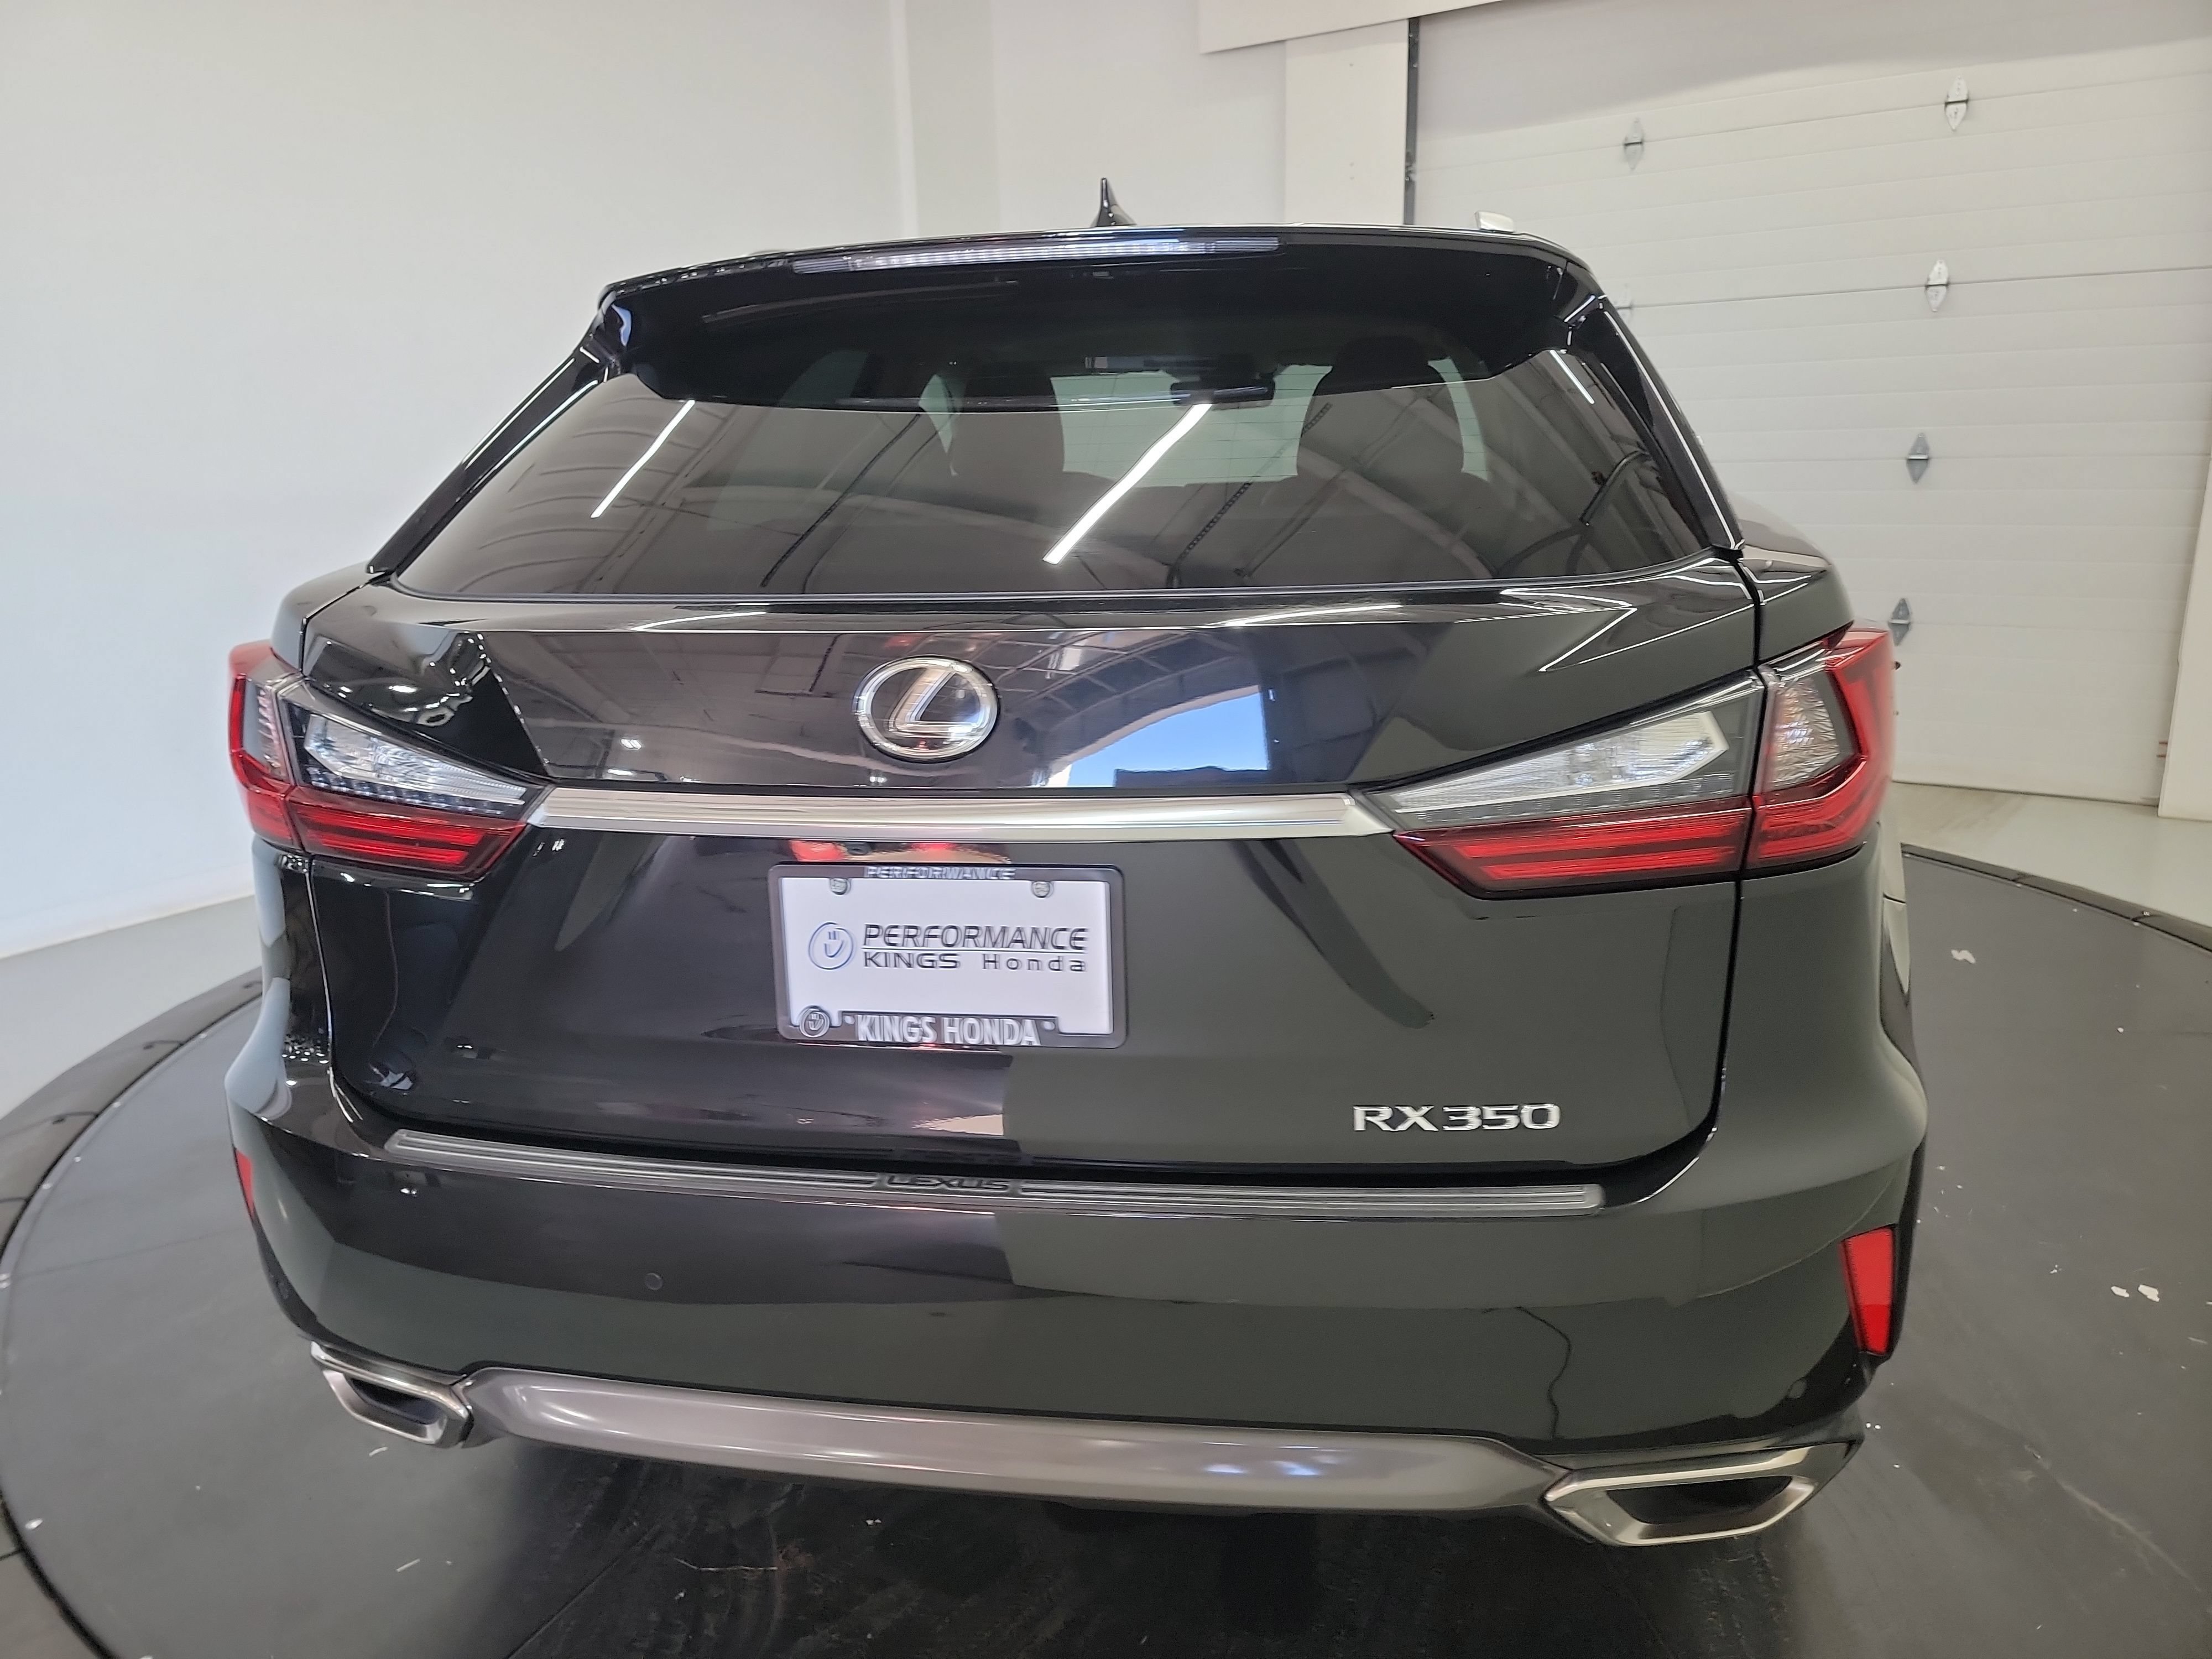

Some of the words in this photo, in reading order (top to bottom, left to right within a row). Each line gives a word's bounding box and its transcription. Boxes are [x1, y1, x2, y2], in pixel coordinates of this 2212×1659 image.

[863, 924, 1089, 951] PERFORMANCE
[863, 952, 961, 969] KINGS
[982, 953, 1087, 972] Honda
[855, 1014, 937, 1043] KINGS
[943, 1017, 1041, 1046] HONDA
[887, 1175, 1010, 1192] LEXUS
